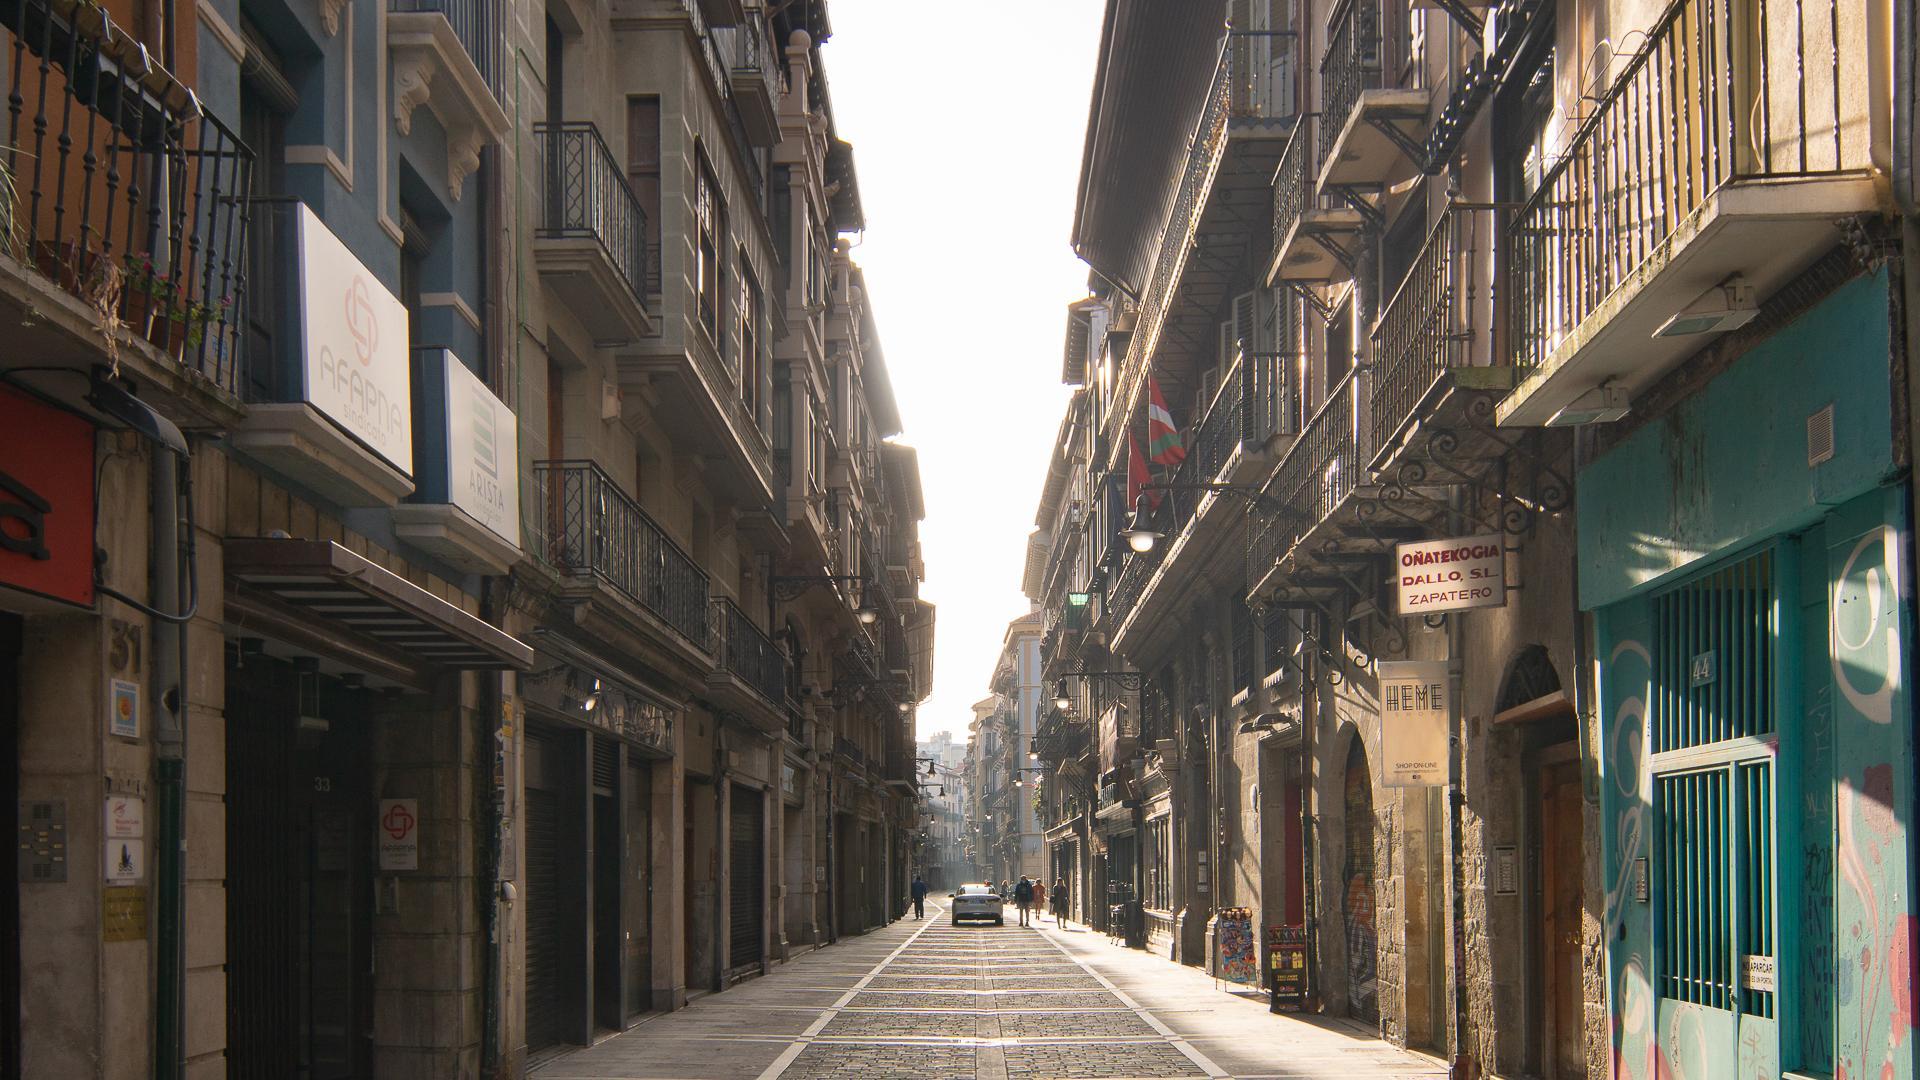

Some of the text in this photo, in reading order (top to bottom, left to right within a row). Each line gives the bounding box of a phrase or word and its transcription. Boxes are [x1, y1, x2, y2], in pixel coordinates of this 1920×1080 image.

[320, 345, 403, 442] AFAPNA
[343, 403, 387, 446] sindicato
[469, 469, 505, 512] ARISTA
[1402, 544, 1500, 567] OÑATEKOGIA
[1402, 571, 1463, 586] DALLO,
[1409, 587, 1492, 605] ZAPATERO
[1693, 657, 1708, 679] 44
[1386, 684, 1442, 711] HEME
[314, 776, 331, 792] 33
[1750, 962, 1773, 974] APARCAR
